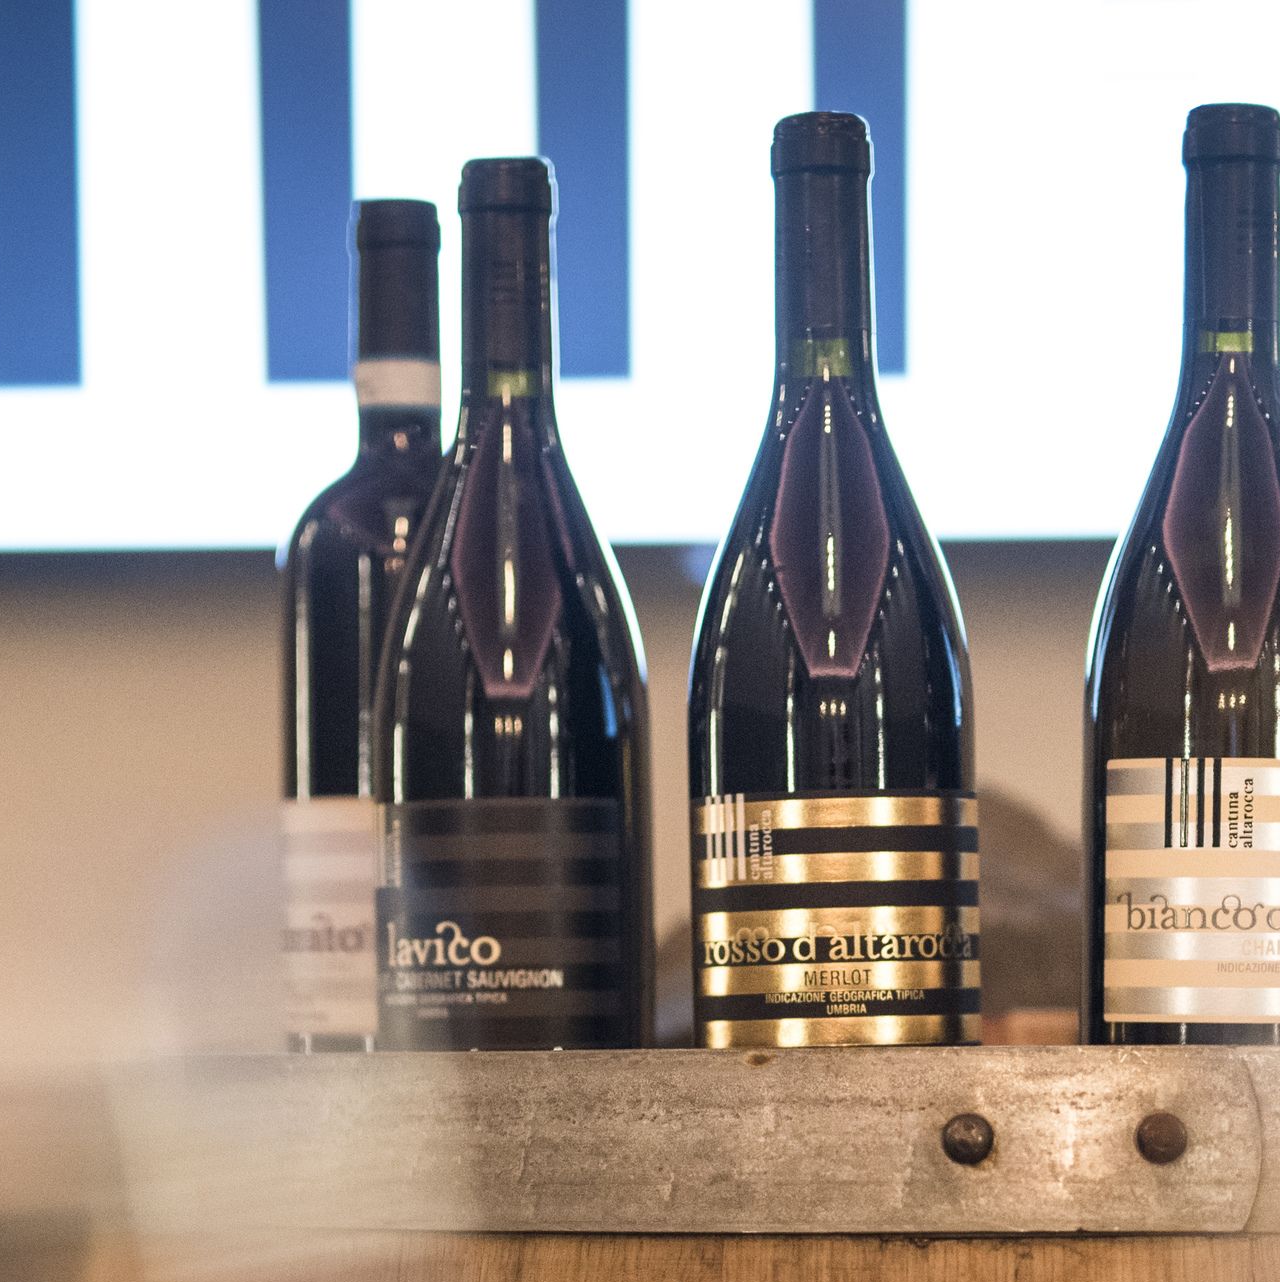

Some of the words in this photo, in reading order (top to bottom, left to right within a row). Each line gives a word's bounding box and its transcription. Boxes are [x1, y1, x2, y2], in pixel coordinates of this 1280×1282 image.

[1228, 792, 1239, 848] cantina
[1239, 778, 1254, 848] altarocca
[1117, 892, 1265, 931] bianco
[387, 920, 502, 967] lavico
[704, 926, 786, 965] rosso
[467, 968, 564, 989] SAUVIGNON
[804, 969, 873, 988] MERLOT
[1217, 962, 1280, 974] INDICAZIONE
[765, 991, 827, 1004] INDICAZIONE
[830, 990, 893, 1002] GEOGRAFICA
[896, 988, 925, 1001] TIPICA
[826, 1003, 867, 1015] UMBRIA
